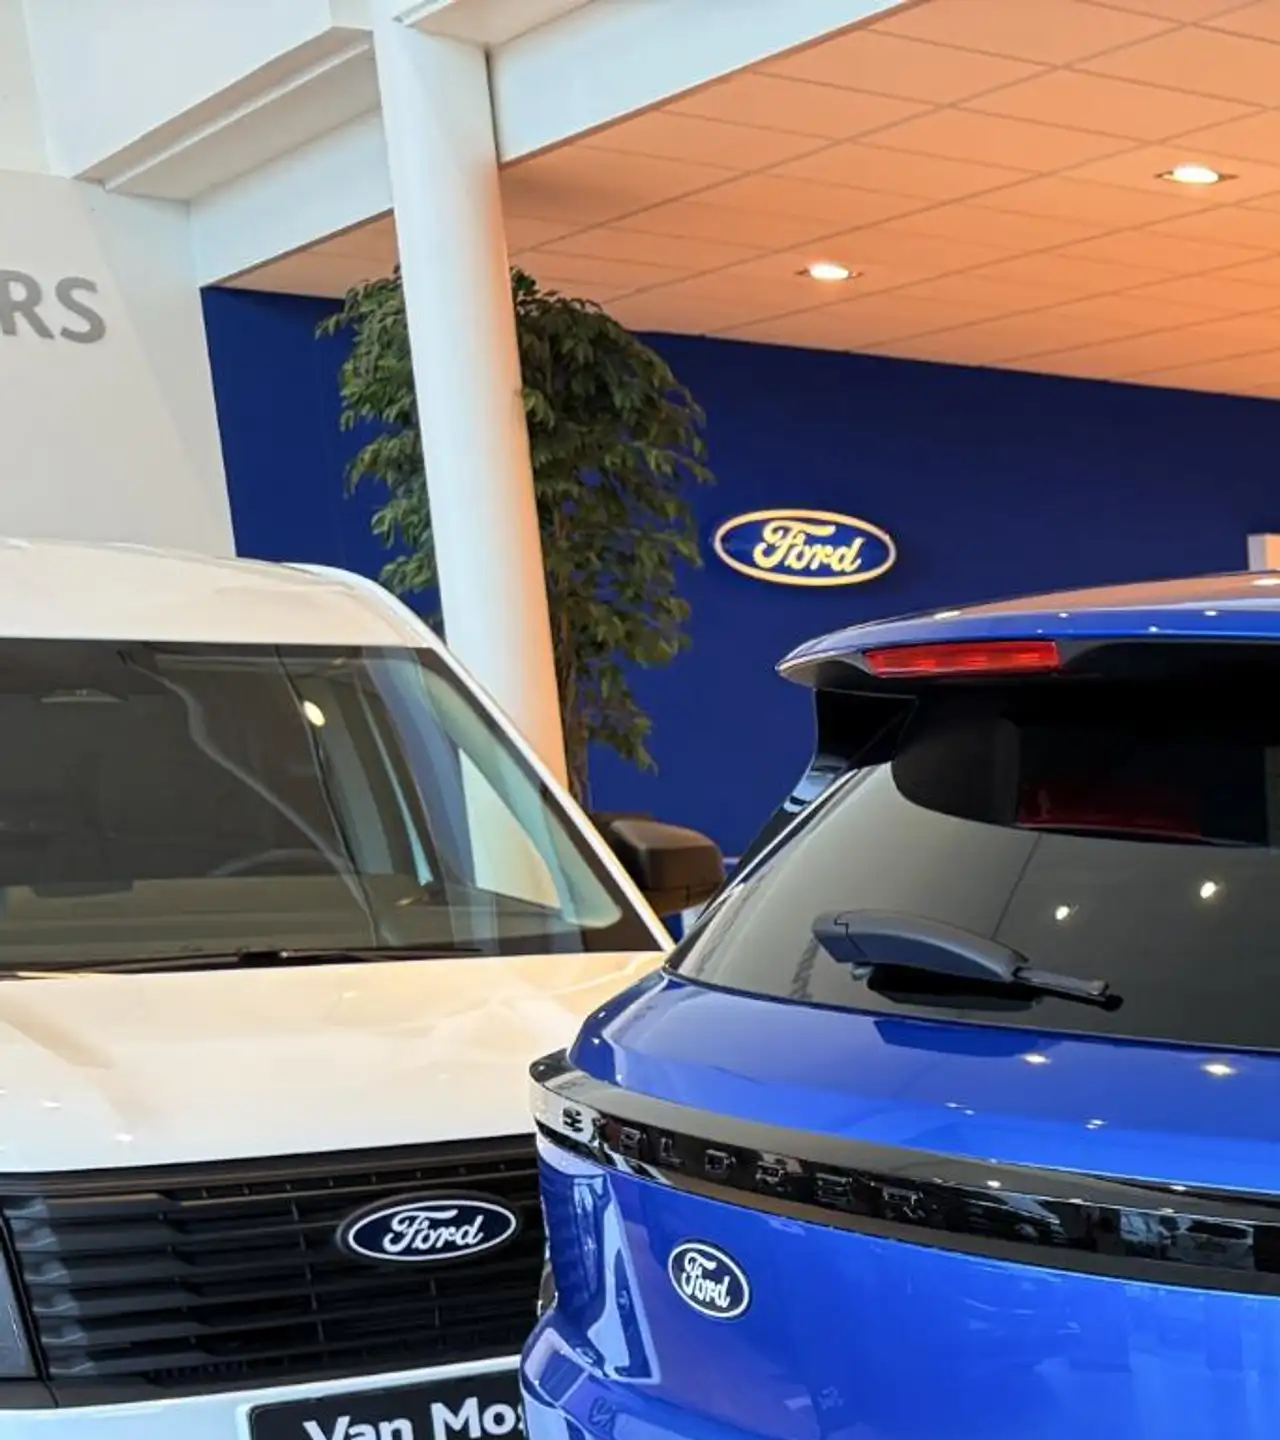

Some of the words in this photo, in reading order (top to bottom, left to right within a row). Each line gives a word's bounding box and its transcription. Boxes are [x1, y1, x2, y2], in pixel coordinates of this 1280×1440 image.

[753, 519, 867, 574] Ford
[382, 1208, 484, 1253] Ford
[681, 1251, 731, 1309] Ford
